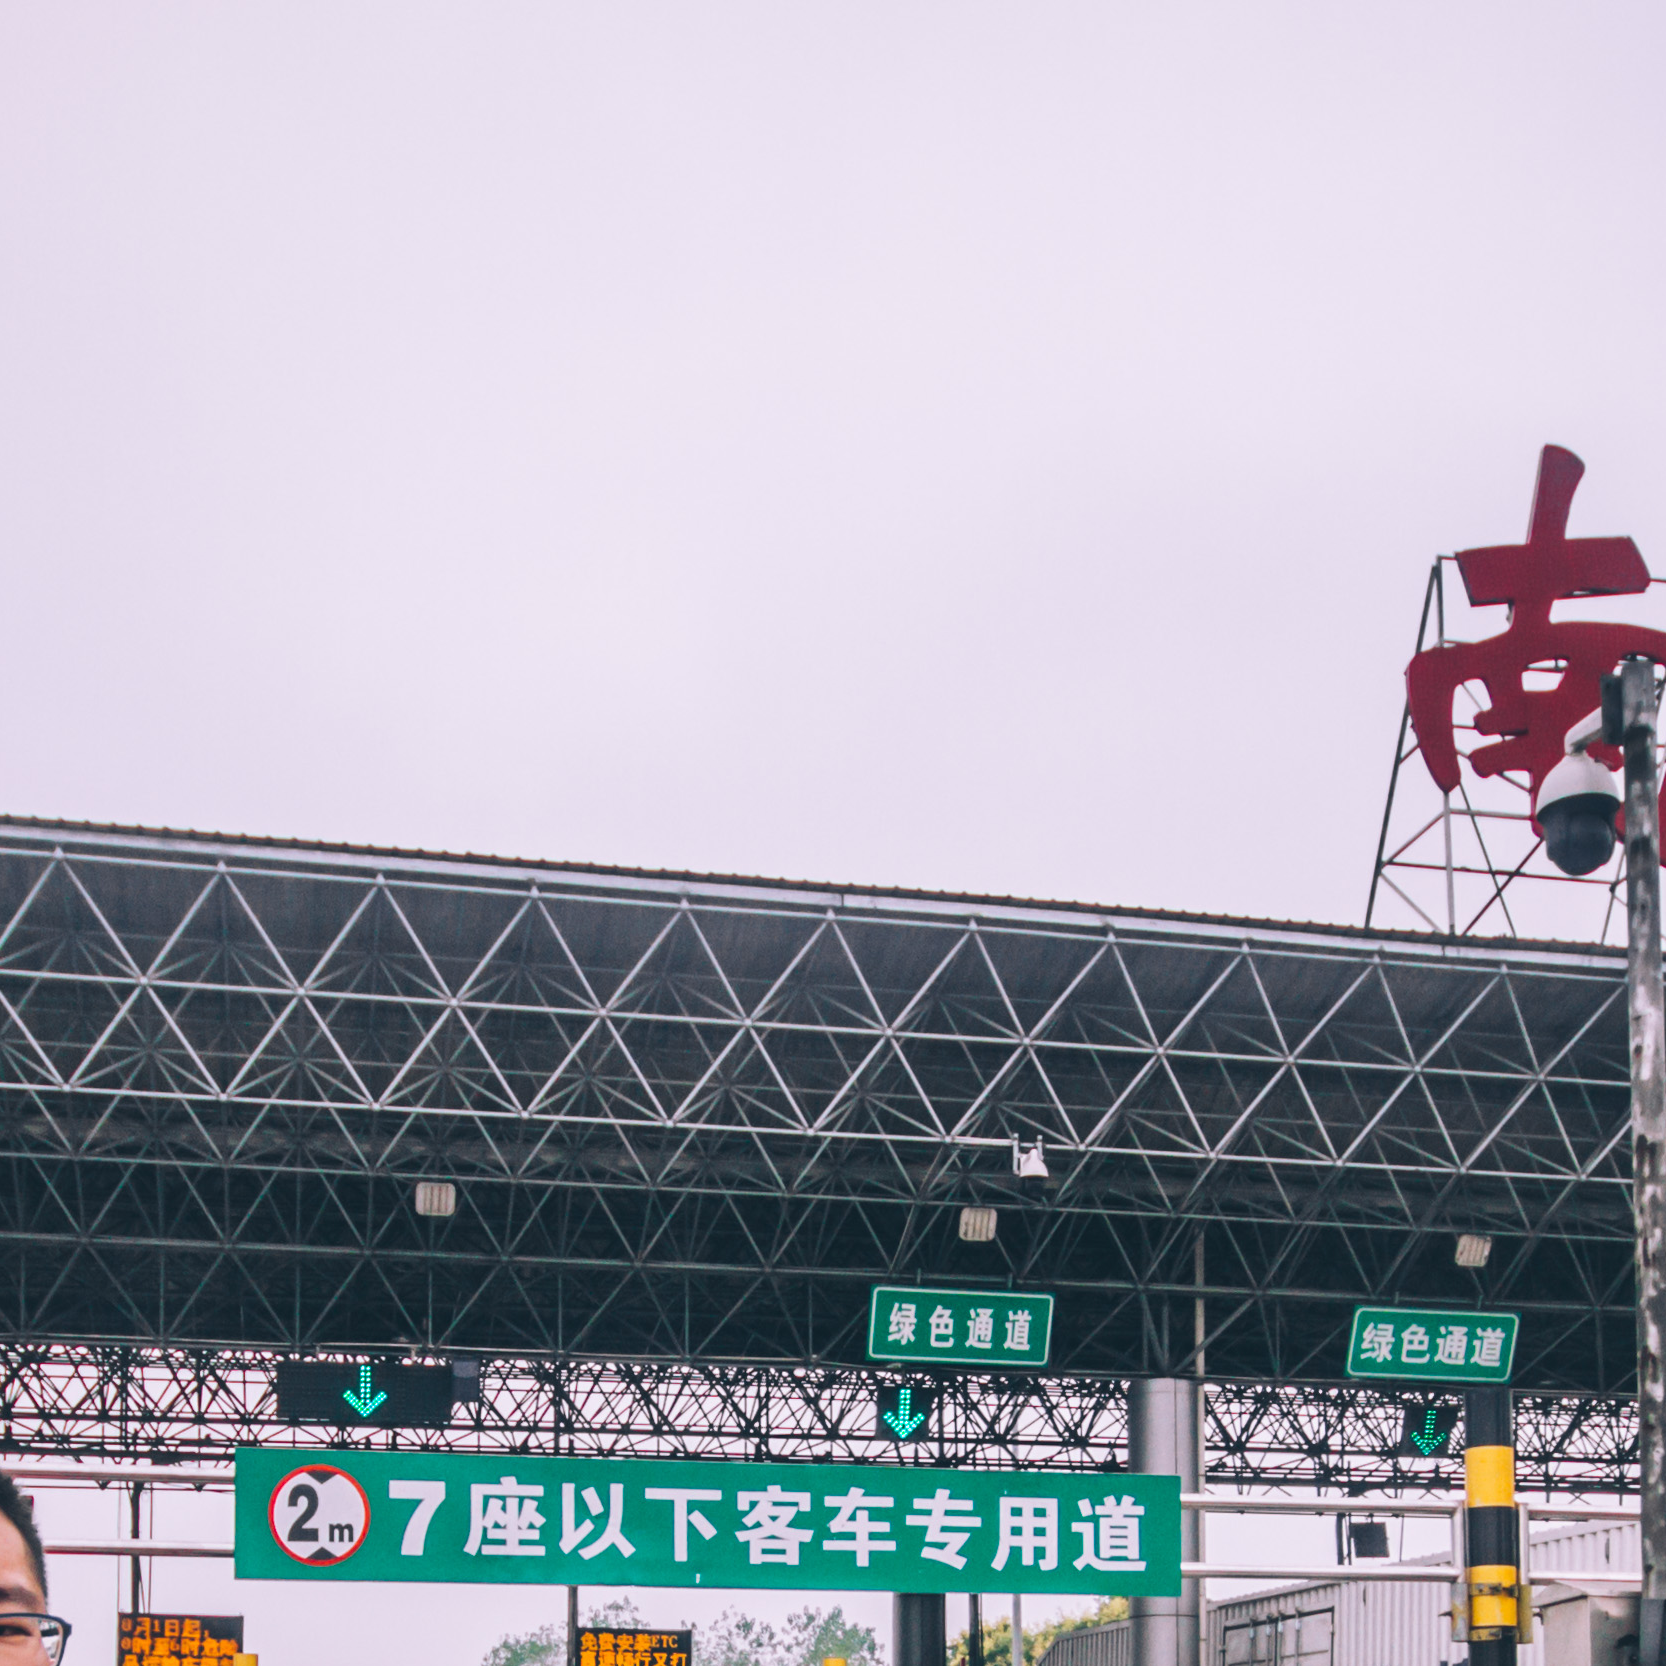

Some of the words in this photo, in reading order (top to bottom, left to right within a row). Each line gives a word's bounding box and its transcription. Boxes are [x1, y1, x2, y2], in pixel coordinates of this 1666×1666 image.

[887, 1301, 1033, 1352] 绿色通道
[1359, 1320, 1507, 1368] 绿色通道
[388, 1474, 1148, 1572] 7座以下客车专用道
[580, 1631, 679, 1651] 免费安装ETC
